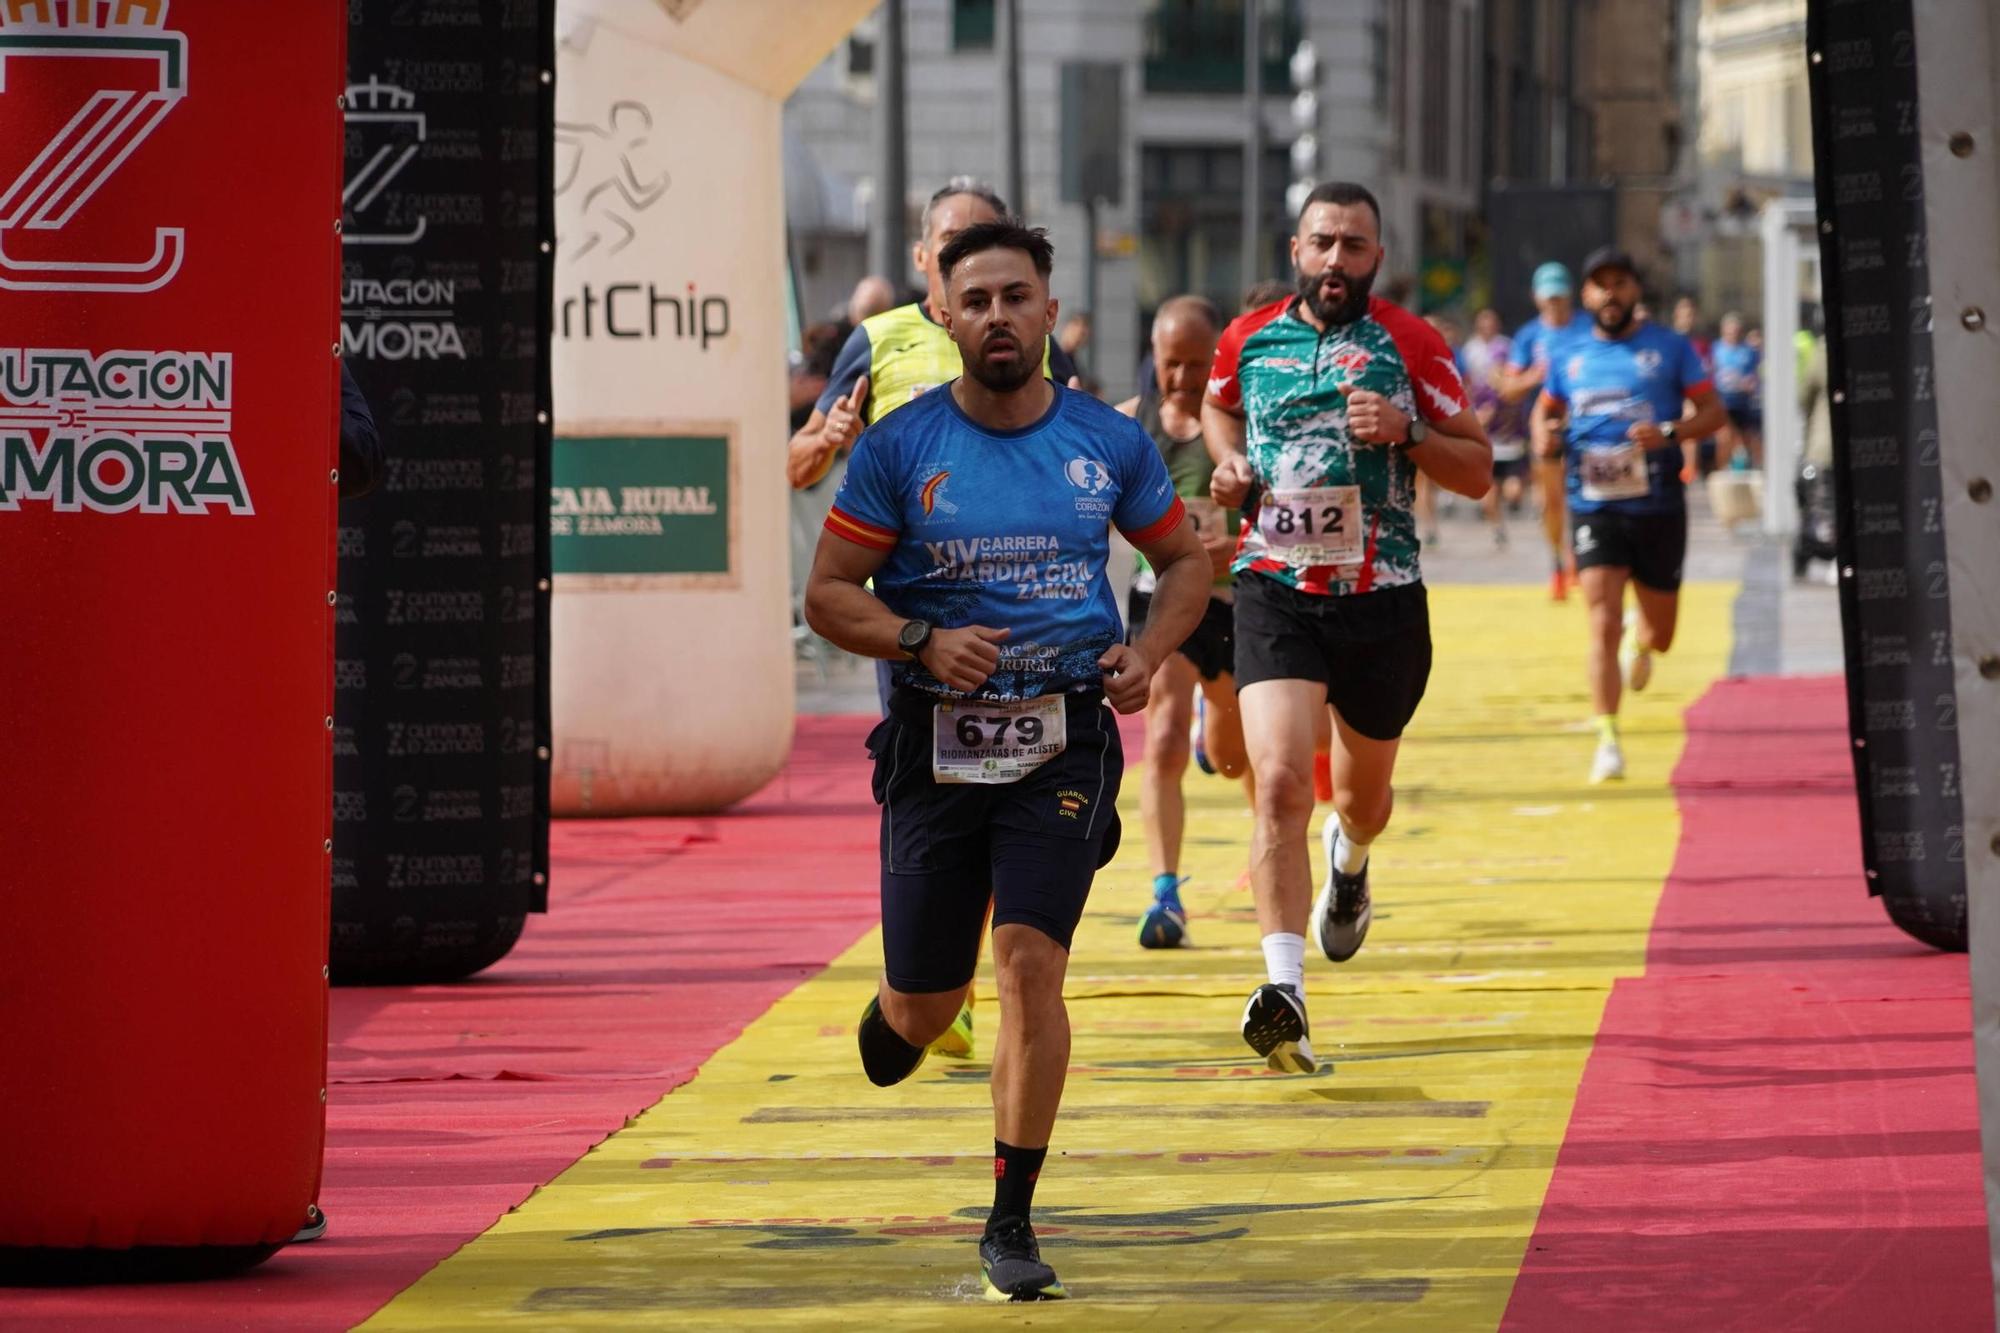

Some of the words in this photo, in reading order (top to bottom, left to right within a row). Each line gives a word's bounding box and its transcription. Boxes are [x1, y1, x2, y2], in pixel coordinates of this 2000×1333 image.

[0, 437, 247, 507] MORA
[620, 486, 718, 515] RURAL
[577, 516, 664, 535] ZAMORA
[1276, 506, 1344, 535] 812
[925, 537, 980, 568] XIV
[980, 536, 1059, 551] CARRERA
[981, 551, 1057, 564] POPULAR
[1000, 658, 1056, 671] RURAL
[956, 714, 1044, 747] 679
[940, 748, 1010, 759] RIOMANZANAS
[1012, 747, 1025, 757] DE
[1027, 743, 1060, 755] ALISTE
[1056, 790, 1089, 804] GUARDIA
[1059, 809, 1078, 819] CIVIL
